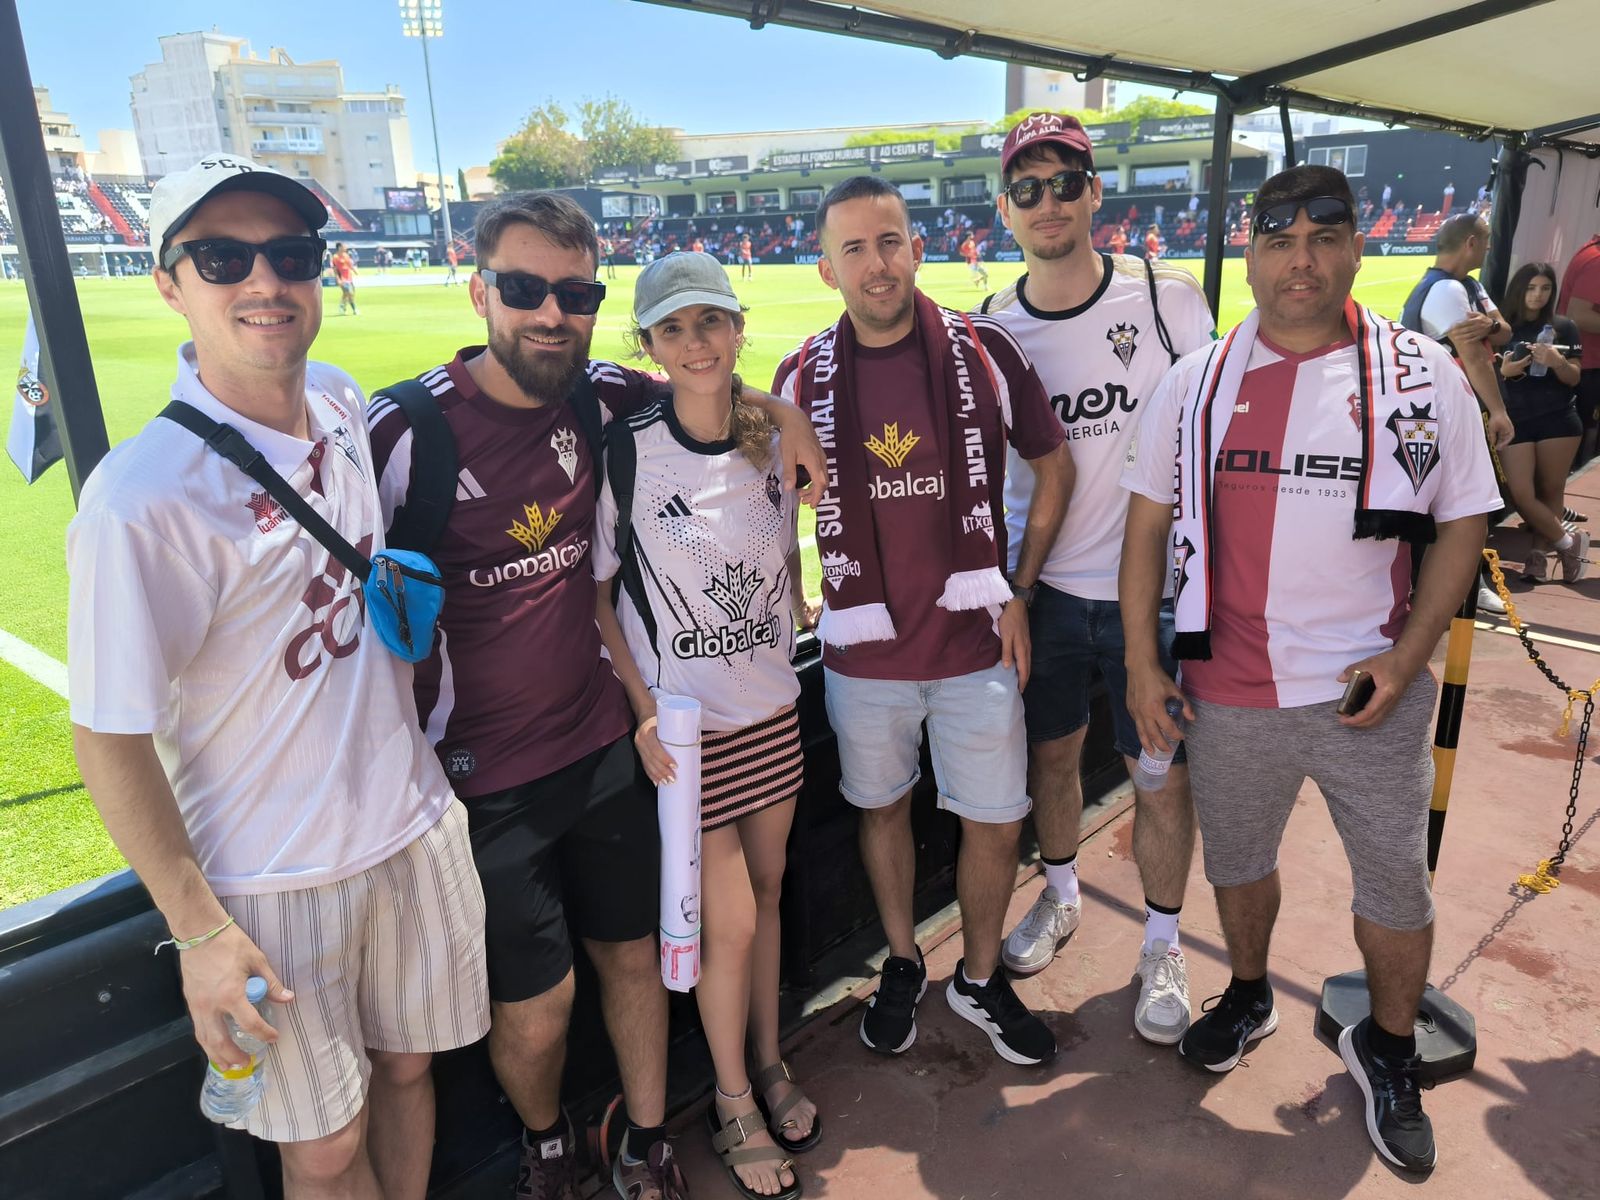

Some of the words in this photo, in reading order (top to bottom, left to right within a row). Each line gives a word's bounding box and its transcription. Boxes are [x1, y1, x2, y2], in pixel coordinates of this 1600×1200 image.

[891, 144, 916, 156] CEUTA
[917, 142, 929, 154] FC
[773, 153, 801, 166] ESTADIO
[802, 150, 834, 164] ALFONSO
[1391, 246, 1429, 254] macron
[810, 389, 836, 449] MAL
[1217, 480, 1266, 492] Seguros
[1272, 484, 1311, 496] desde
[1317, 487, 1347, 499] 1933
[256, 507, 290, 535] luanvi
